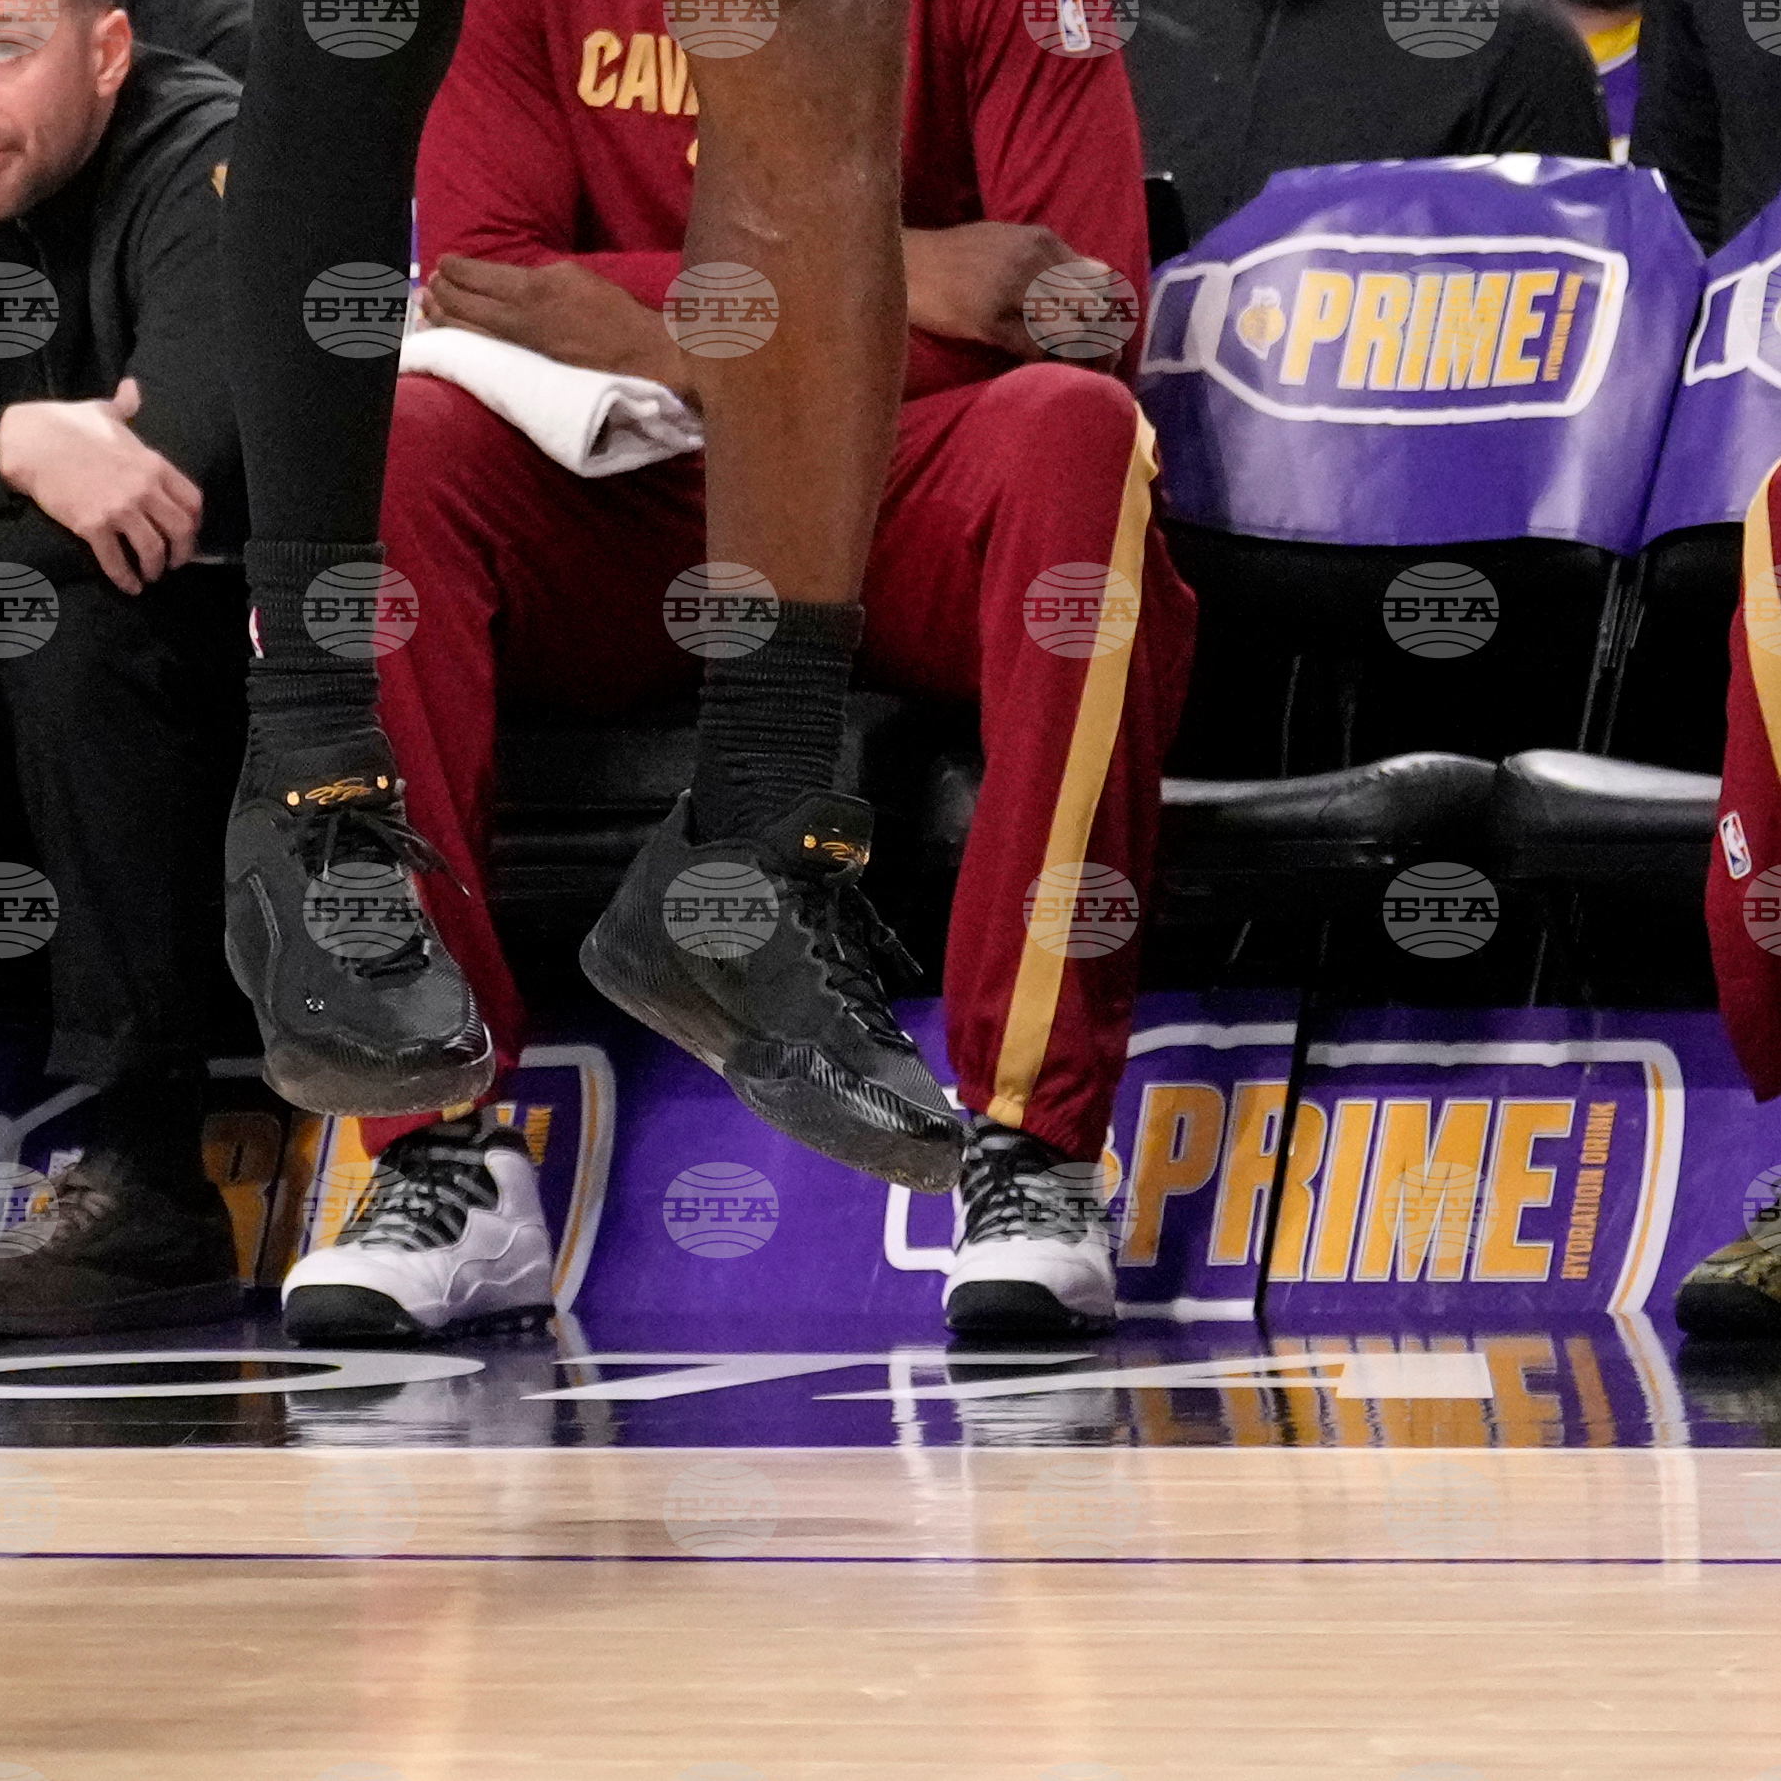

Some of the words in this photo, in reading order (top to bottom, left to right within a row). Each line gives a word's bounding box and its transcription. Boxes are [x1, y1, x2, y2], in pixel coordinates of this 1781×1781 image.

[1279, 270, 1560, 390] PRIME
[1117, 1079, 1576, 1282] PRIME
[1581, 1102, 1617, 1165] DRINK
[1561, 1169, 1605, 1280] HYDRATION
